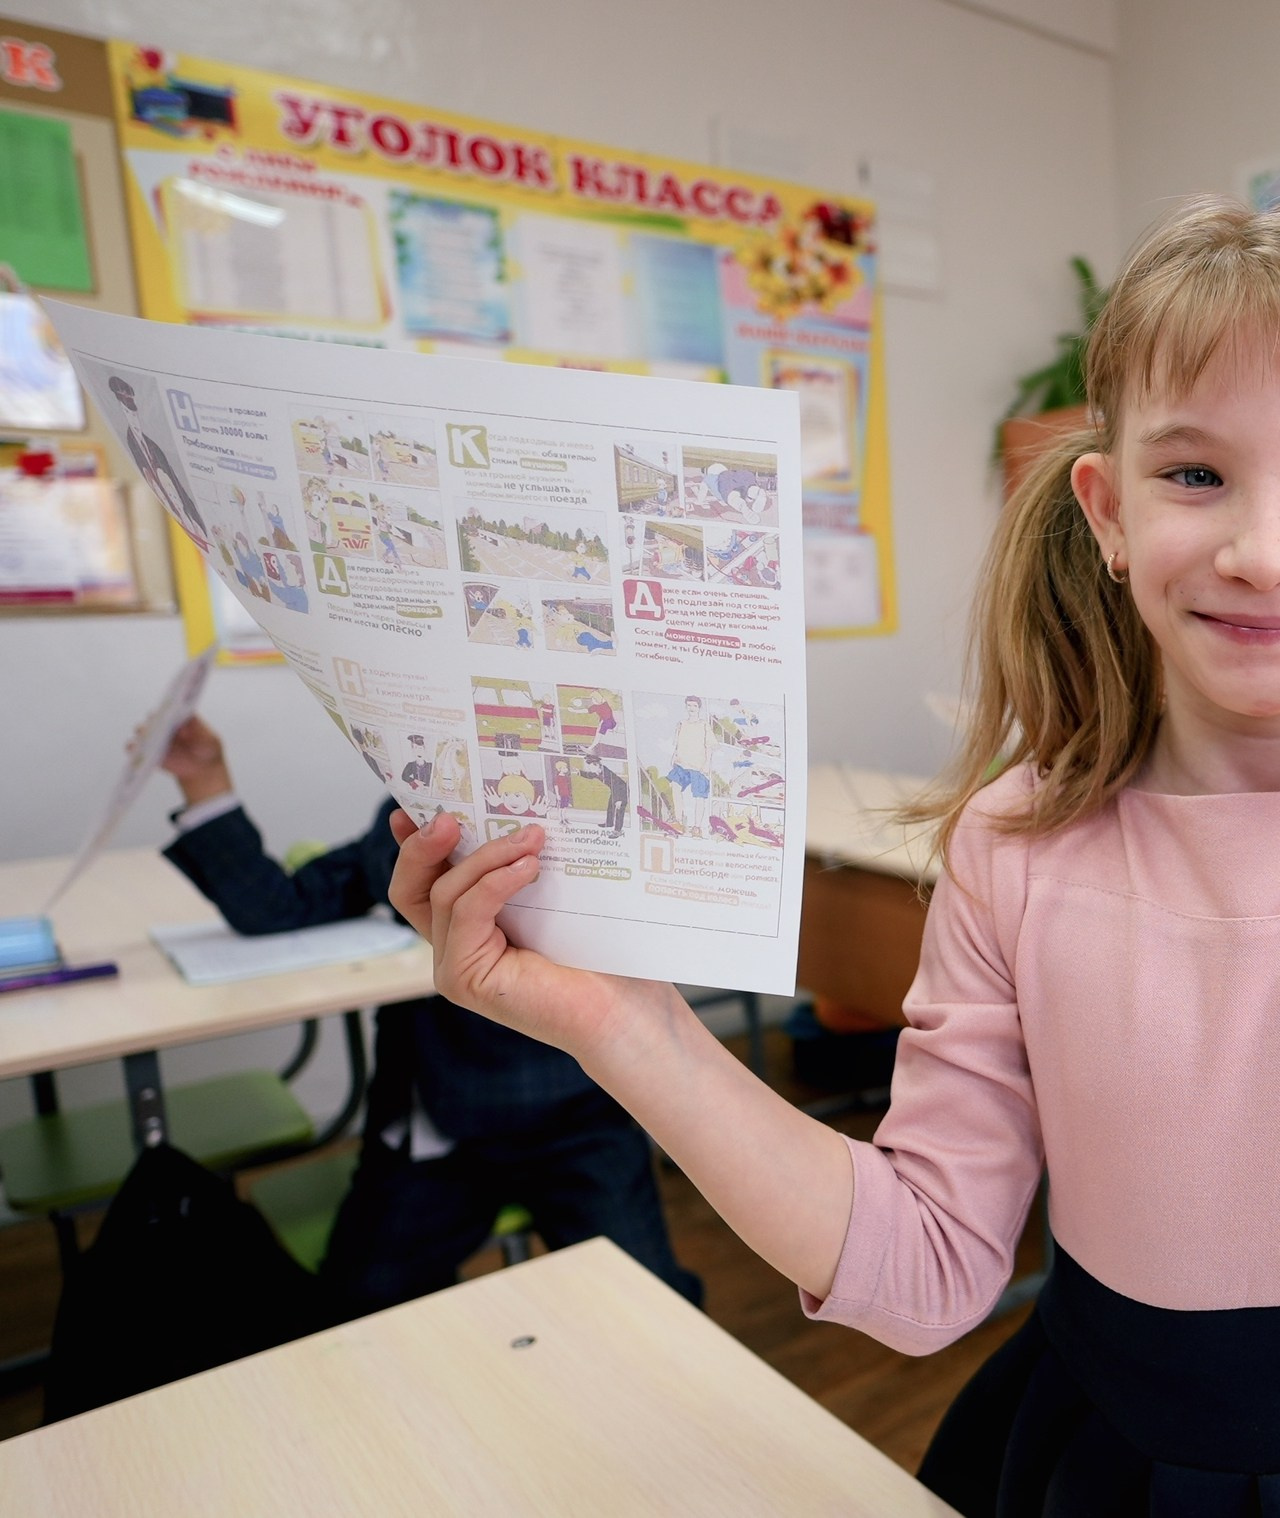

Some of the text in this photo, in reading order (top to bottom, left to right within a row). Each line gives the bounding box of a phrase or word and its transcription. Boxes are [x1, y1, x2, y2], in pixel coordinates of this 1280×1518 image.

[277, 93, 550, 187] УГОЛОК
[570, 155, 781, 222] КЛАССА
[541, 449, 597, 463] обязательно
[503, 481, 517, 491] не
[518, 482, 571, 496] услышать
[550, 494, 588, 505] поезда
[356, 565, 394, 576] перехода
[385, 594, 432, 606] подземные
[703, 590, 729, 598] очень
[353, 601, 395, 612] надземные
[663, 596, 780, 612] не подлезай под стоящий
[708, 610, 757, 621] перелезай
[665, 618, 695, 628] сцепку
[697, 621, 727, 630] между
[634, 626, 664, 638] Состав
[665, 632, 695, 643] может
[696, 635, 741, 648] тронуться
[748, 642, 777, 652] любой
[692, 645, 733, 659] будешь
[734, 652, 766, 663] ранен
[565, 827, 599, 836] десятки
[674, 856, 715, 867] кататься
[674, 867, 730, 880] скейтборде
[717, 886, 758, 898] можешь
